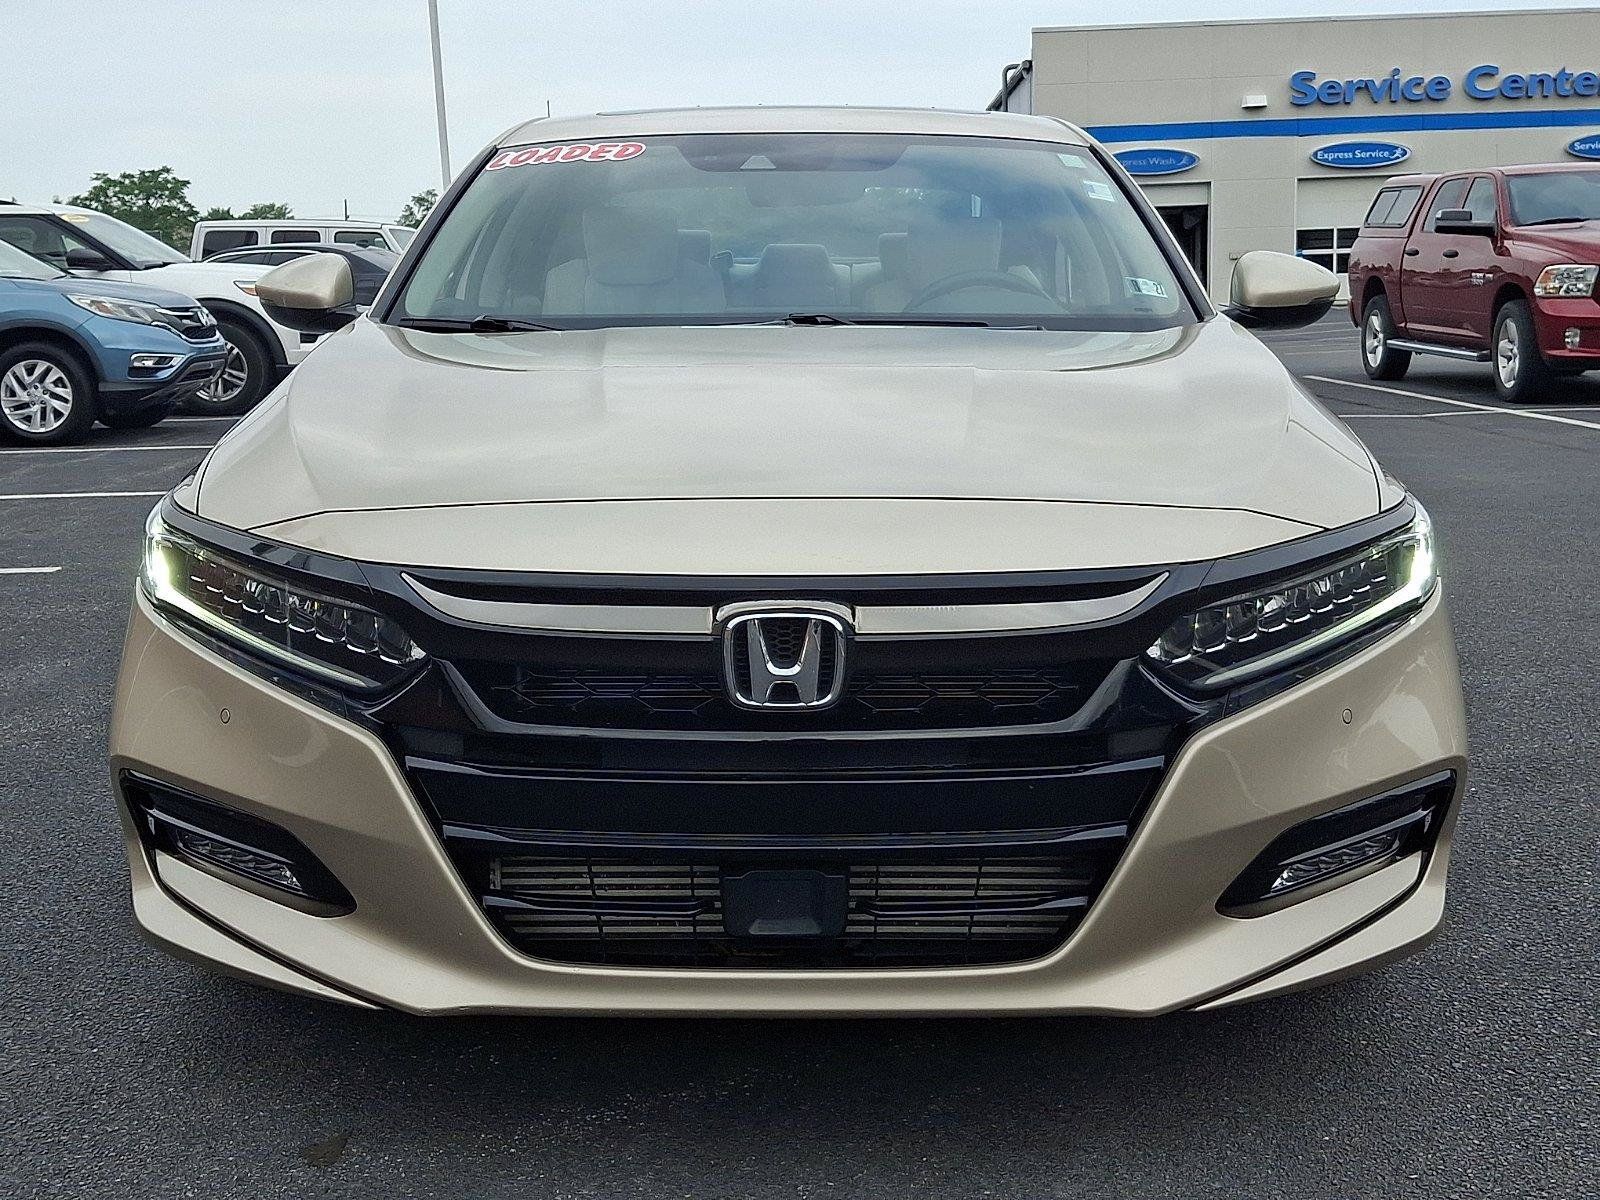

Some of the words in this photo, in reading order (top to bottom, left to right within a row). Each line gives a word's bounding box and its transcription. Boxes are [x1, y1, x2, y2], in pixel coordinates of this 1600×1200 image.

[1290, 68, 1451, 106] Service
[1464, 64, 1600, 99] Cente
[487, 143, 645, 169] LOADED
[1122, 159, 1146, 167] press
[1147, 157, 1176, 166] Wash
[1317, 150, 1353, 161] Express
[1354, 149, 1389, 159] Service
